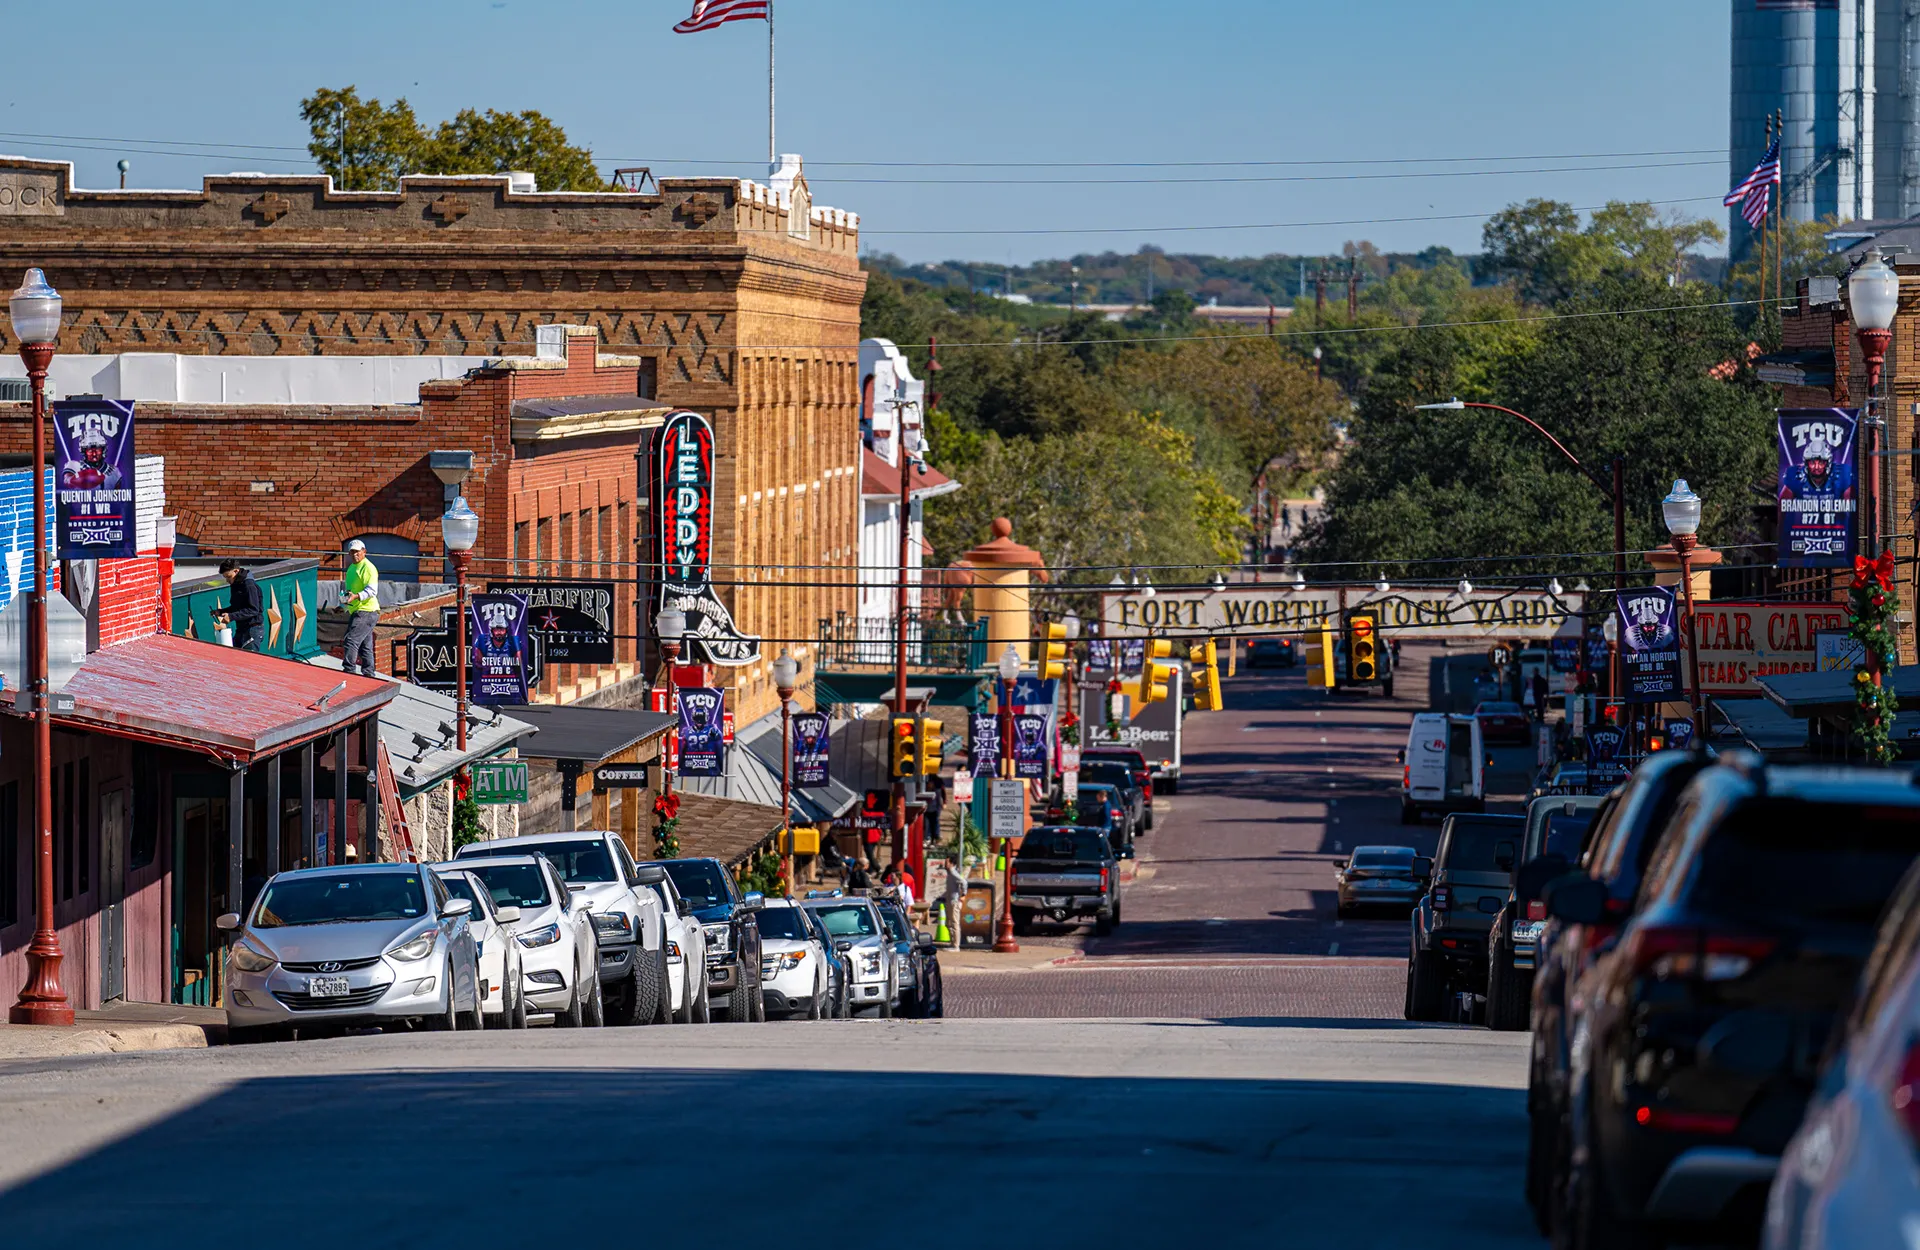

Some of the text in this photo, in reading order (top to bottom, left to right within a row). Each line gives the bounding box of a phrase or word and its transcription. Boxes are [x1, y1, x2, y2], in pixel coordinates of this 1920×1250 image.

[67, 413, 119, 439] TCU
[1791, 422, 1844, 448] TCU
[61, 489, 132, 505] QUENTIN JOHNSTON
[95, 503, 111, 514] WR
[1781, 499, 1856, 512] BRANDON COLEMAN
[481, 603, 518, 620] TCU
[1470, 598, 1568, 628] YARDS
[1628, 597, 1667, 616] TCU
[1117, 599, 1329, 630] FORT WORTH
[698, 615, 751, 659] BOOTS
[1679, 612, 1753, 651] STAR
[549, 648, 569, 657] 1982
[1626, 652, 1677, 664] DYLAN HORTON
[482, 656, 520, 667] STEVE AVILA
[686, 694, 716, 709] TCU
[798, 719, 823, 732] TCU
[975, 719, 997, 729] TCU
[1019, 719, 1042, 730] TCU
[1669, 722, 1691, 734] TCU
[1594, 732, 1619, 744] TCU
[476, 767, 525, 791] ATM
[598, 770, 645, 780] COFFEE
